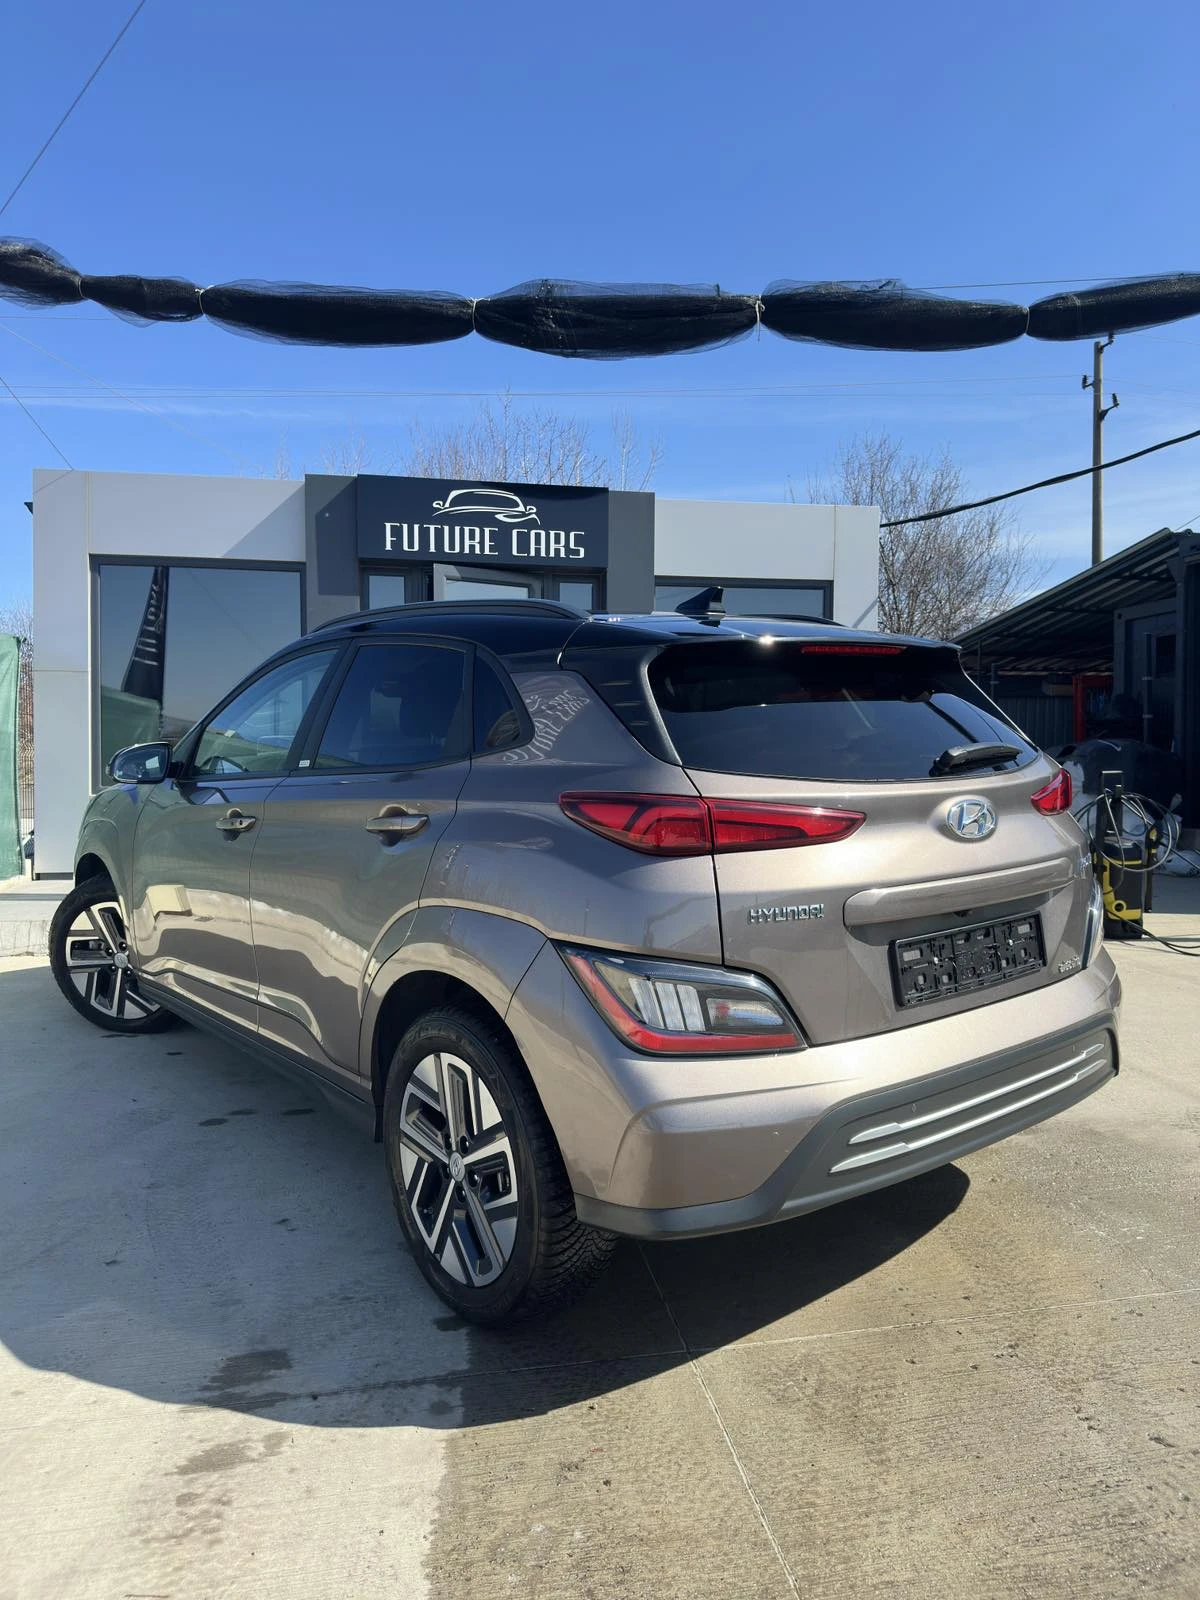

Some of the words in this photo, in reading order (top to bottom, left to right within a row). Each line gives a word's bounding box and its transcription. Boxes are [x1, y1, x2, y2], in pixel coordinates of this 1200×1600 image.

[384, 522, 499, 556] FUTURE
[511, 528, 585, 559] CARS
[750, 903, 825, 923] HYUNDAI
